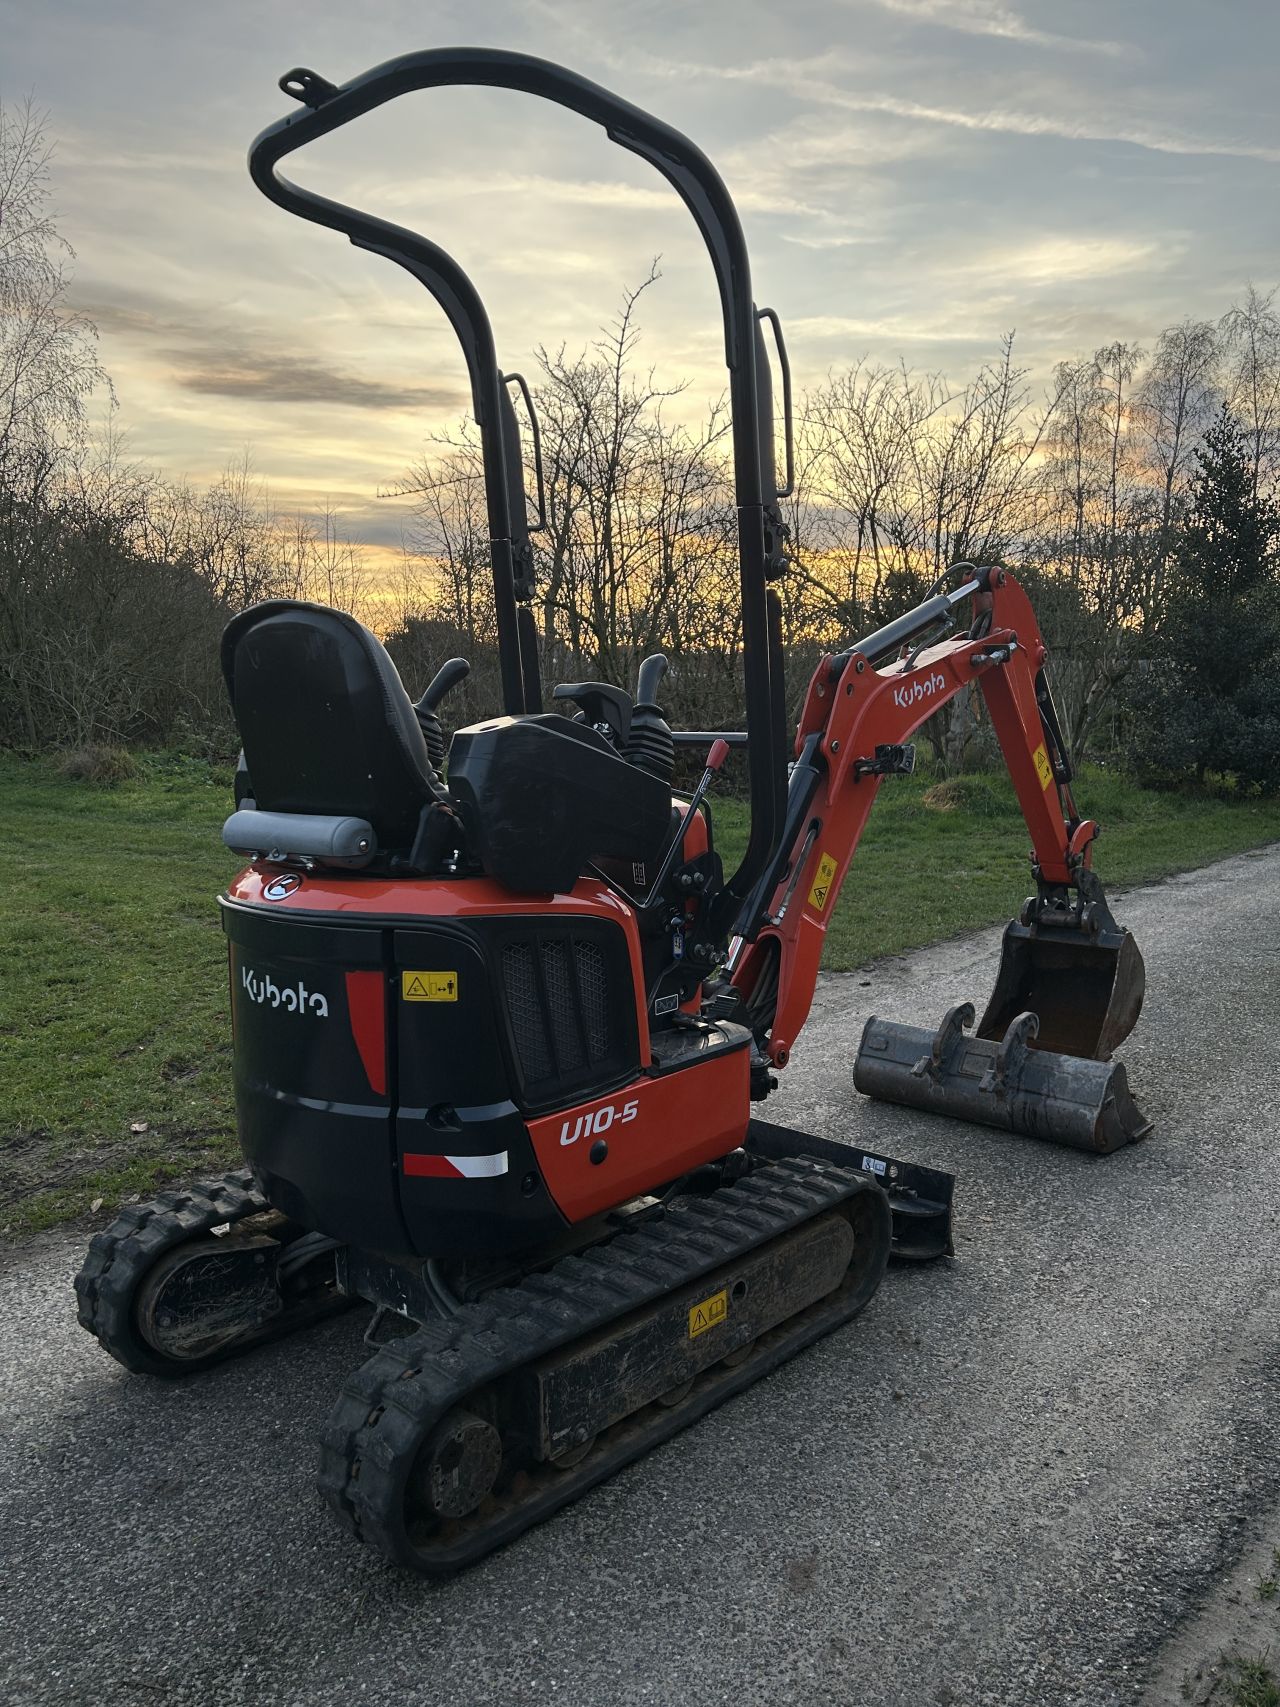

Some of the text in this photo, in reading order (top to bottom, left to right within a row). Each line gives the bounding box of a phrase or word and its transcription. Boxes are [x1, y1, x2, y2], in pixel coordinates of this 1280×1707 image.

[894, 672, 946, 708] Kubota
[241, 966, 330, 1017] Kubota
[560, 1099, 639, 1146] U10-5
